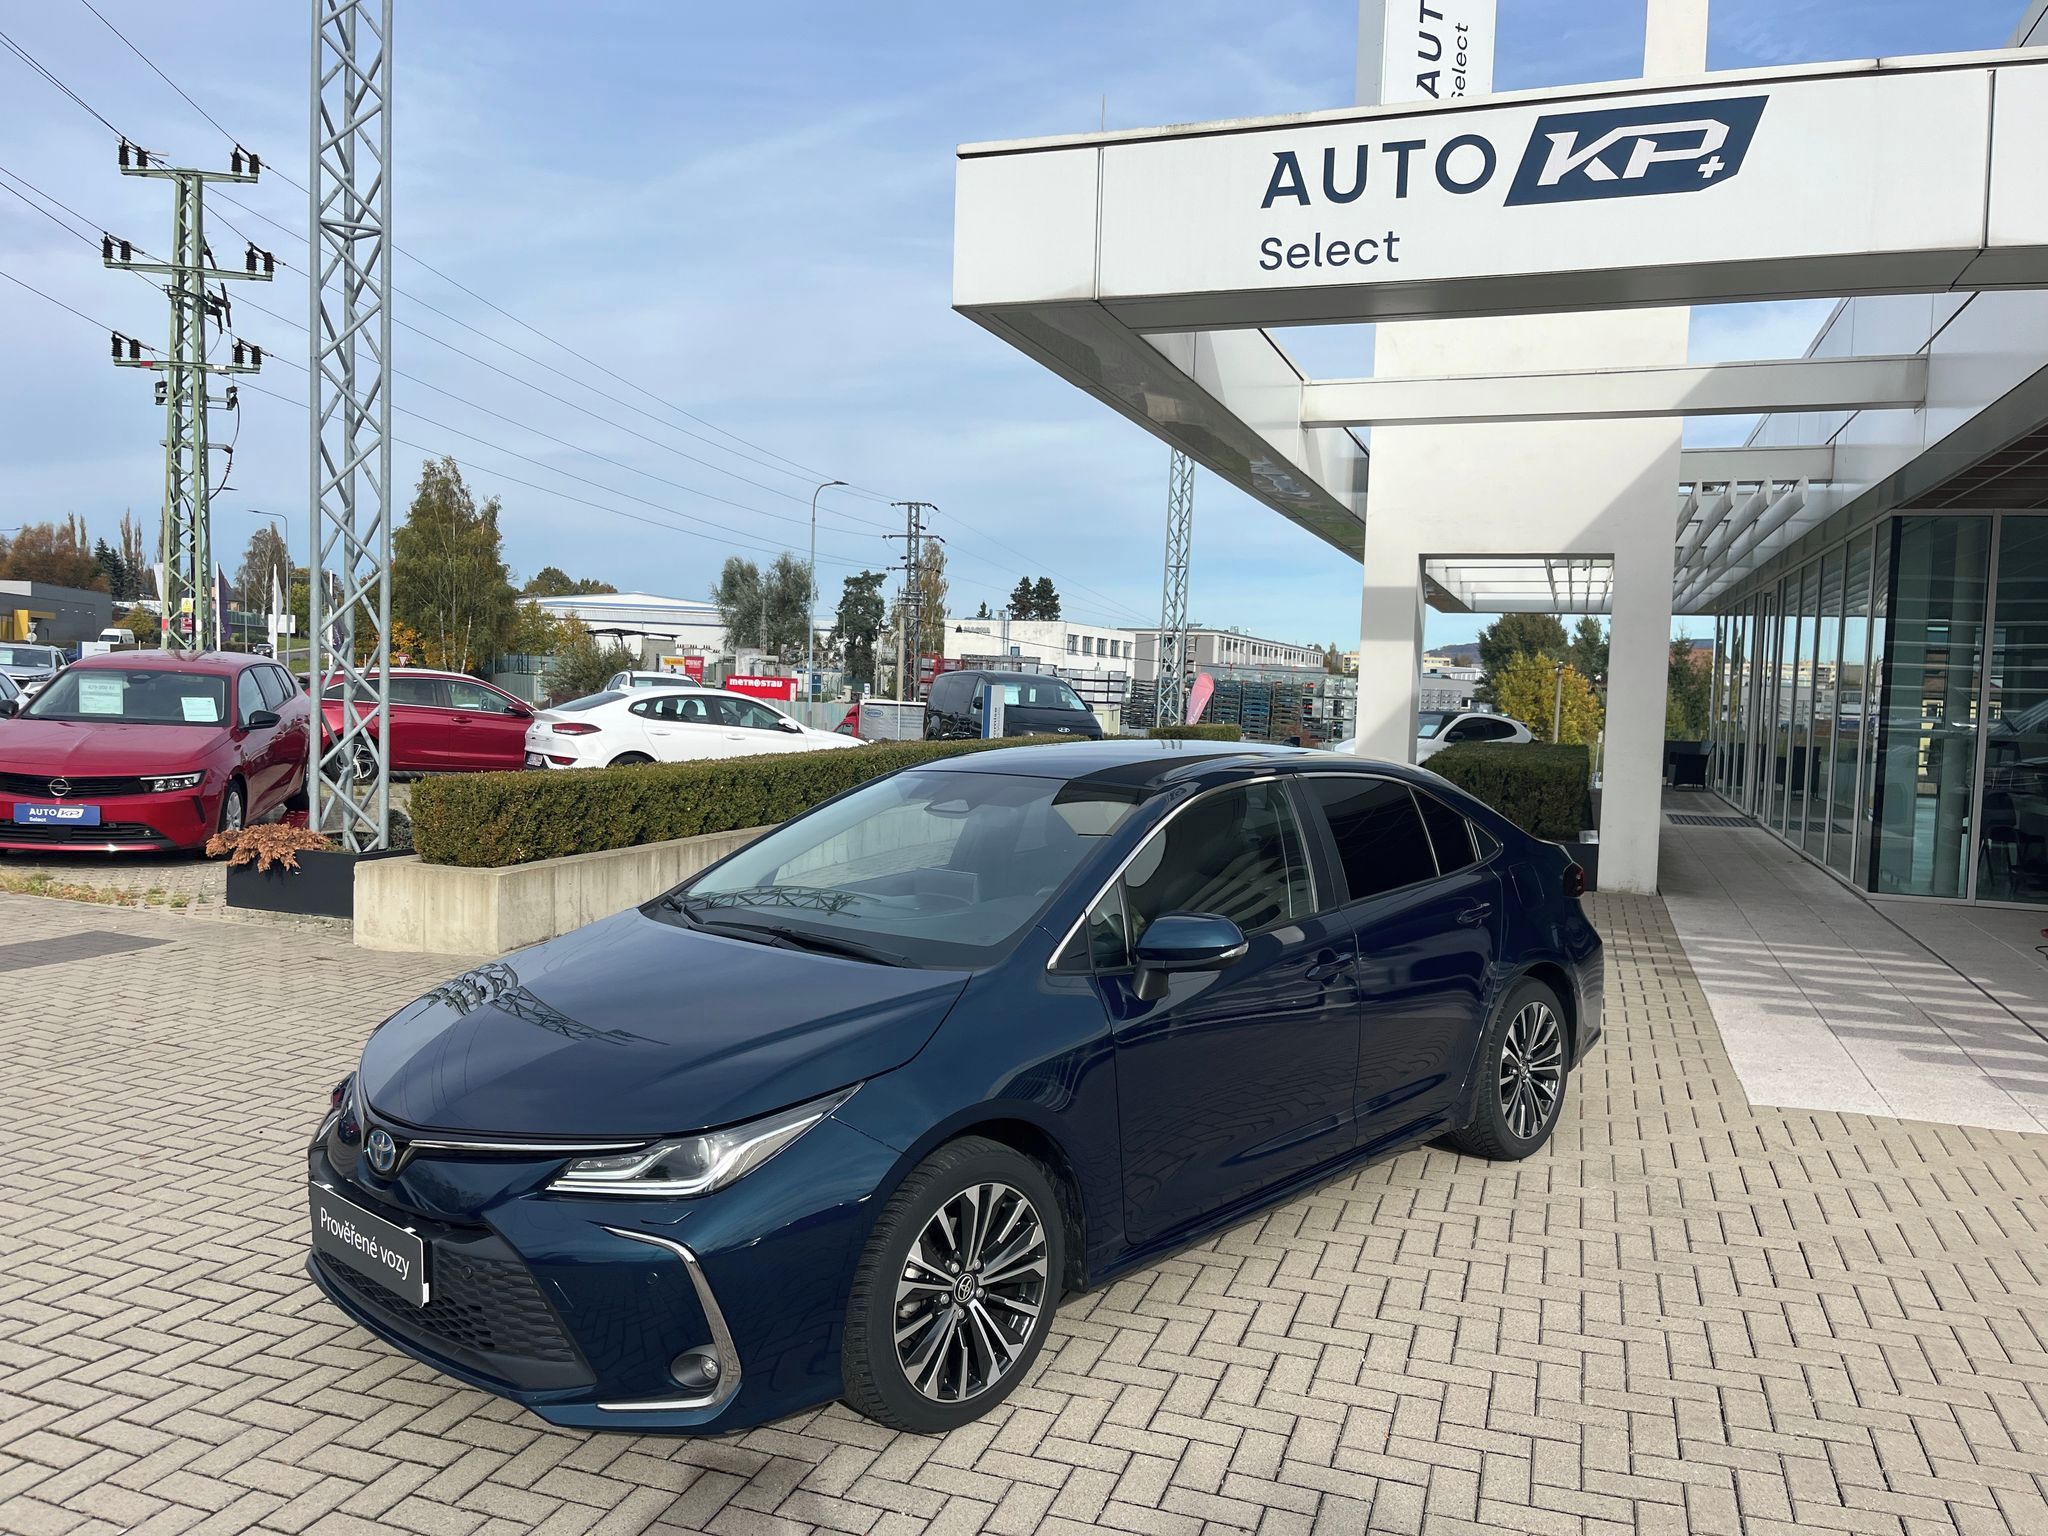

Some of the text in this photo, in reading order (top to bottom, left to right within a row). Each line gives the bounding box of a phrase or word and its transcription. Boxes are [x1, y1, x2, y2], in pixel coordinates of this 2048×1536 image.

[1260, 133, 1497, 209] AUTO
[1259, 230, 1401, 271] Select
[29, 807, 57, 816] AUTO
[320, 1206, 410, 1281] Prověřené vozy
